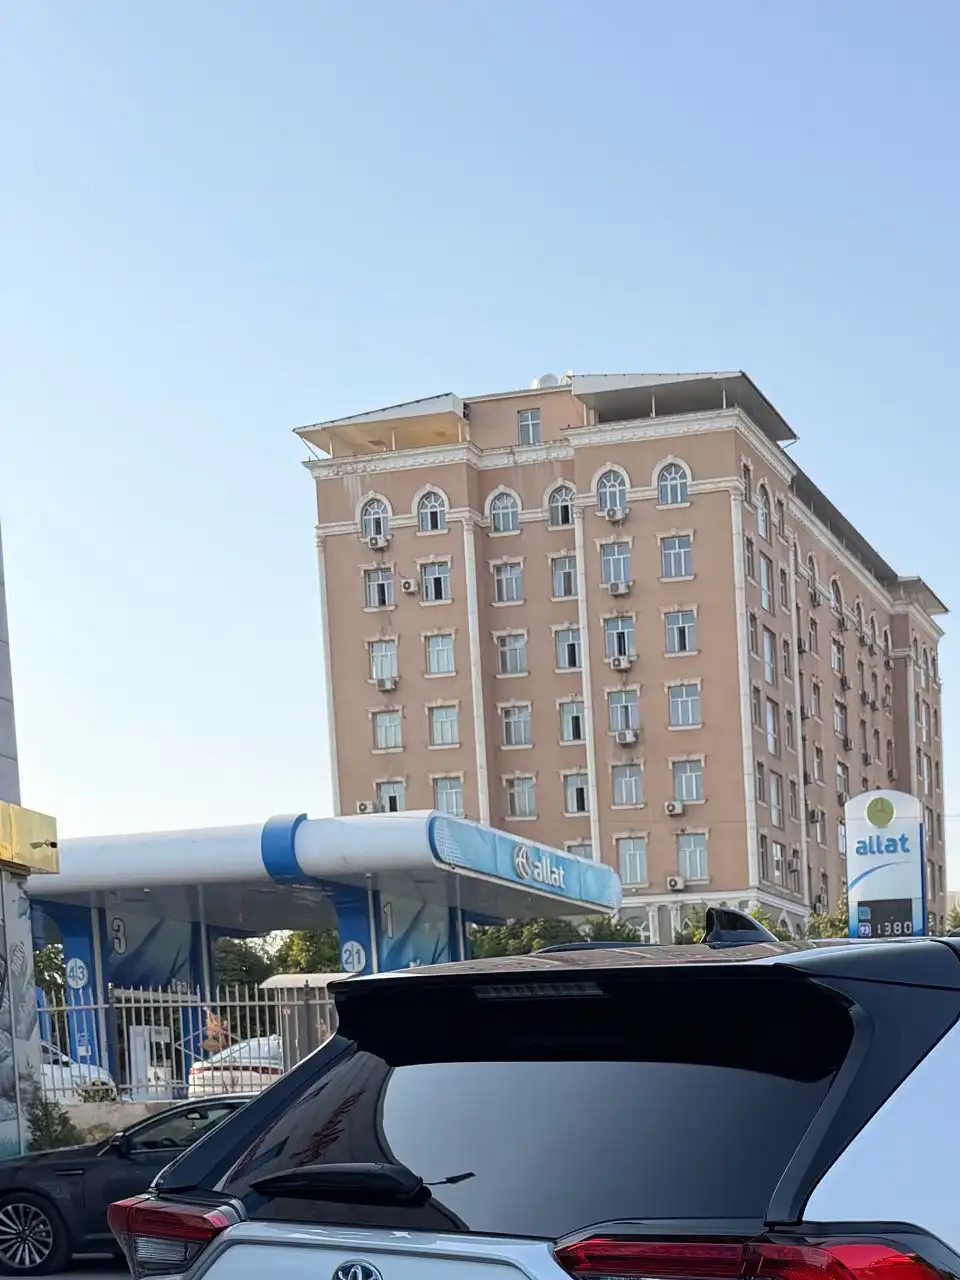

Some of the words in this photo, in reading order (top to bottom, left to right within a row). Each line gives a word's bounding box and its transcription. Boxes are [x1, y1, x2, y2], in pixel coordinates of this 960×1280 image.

[856, 833, 910, 856] allat
[534, 856, 565, 888] allat
[111, 916, 127, 956] 3
